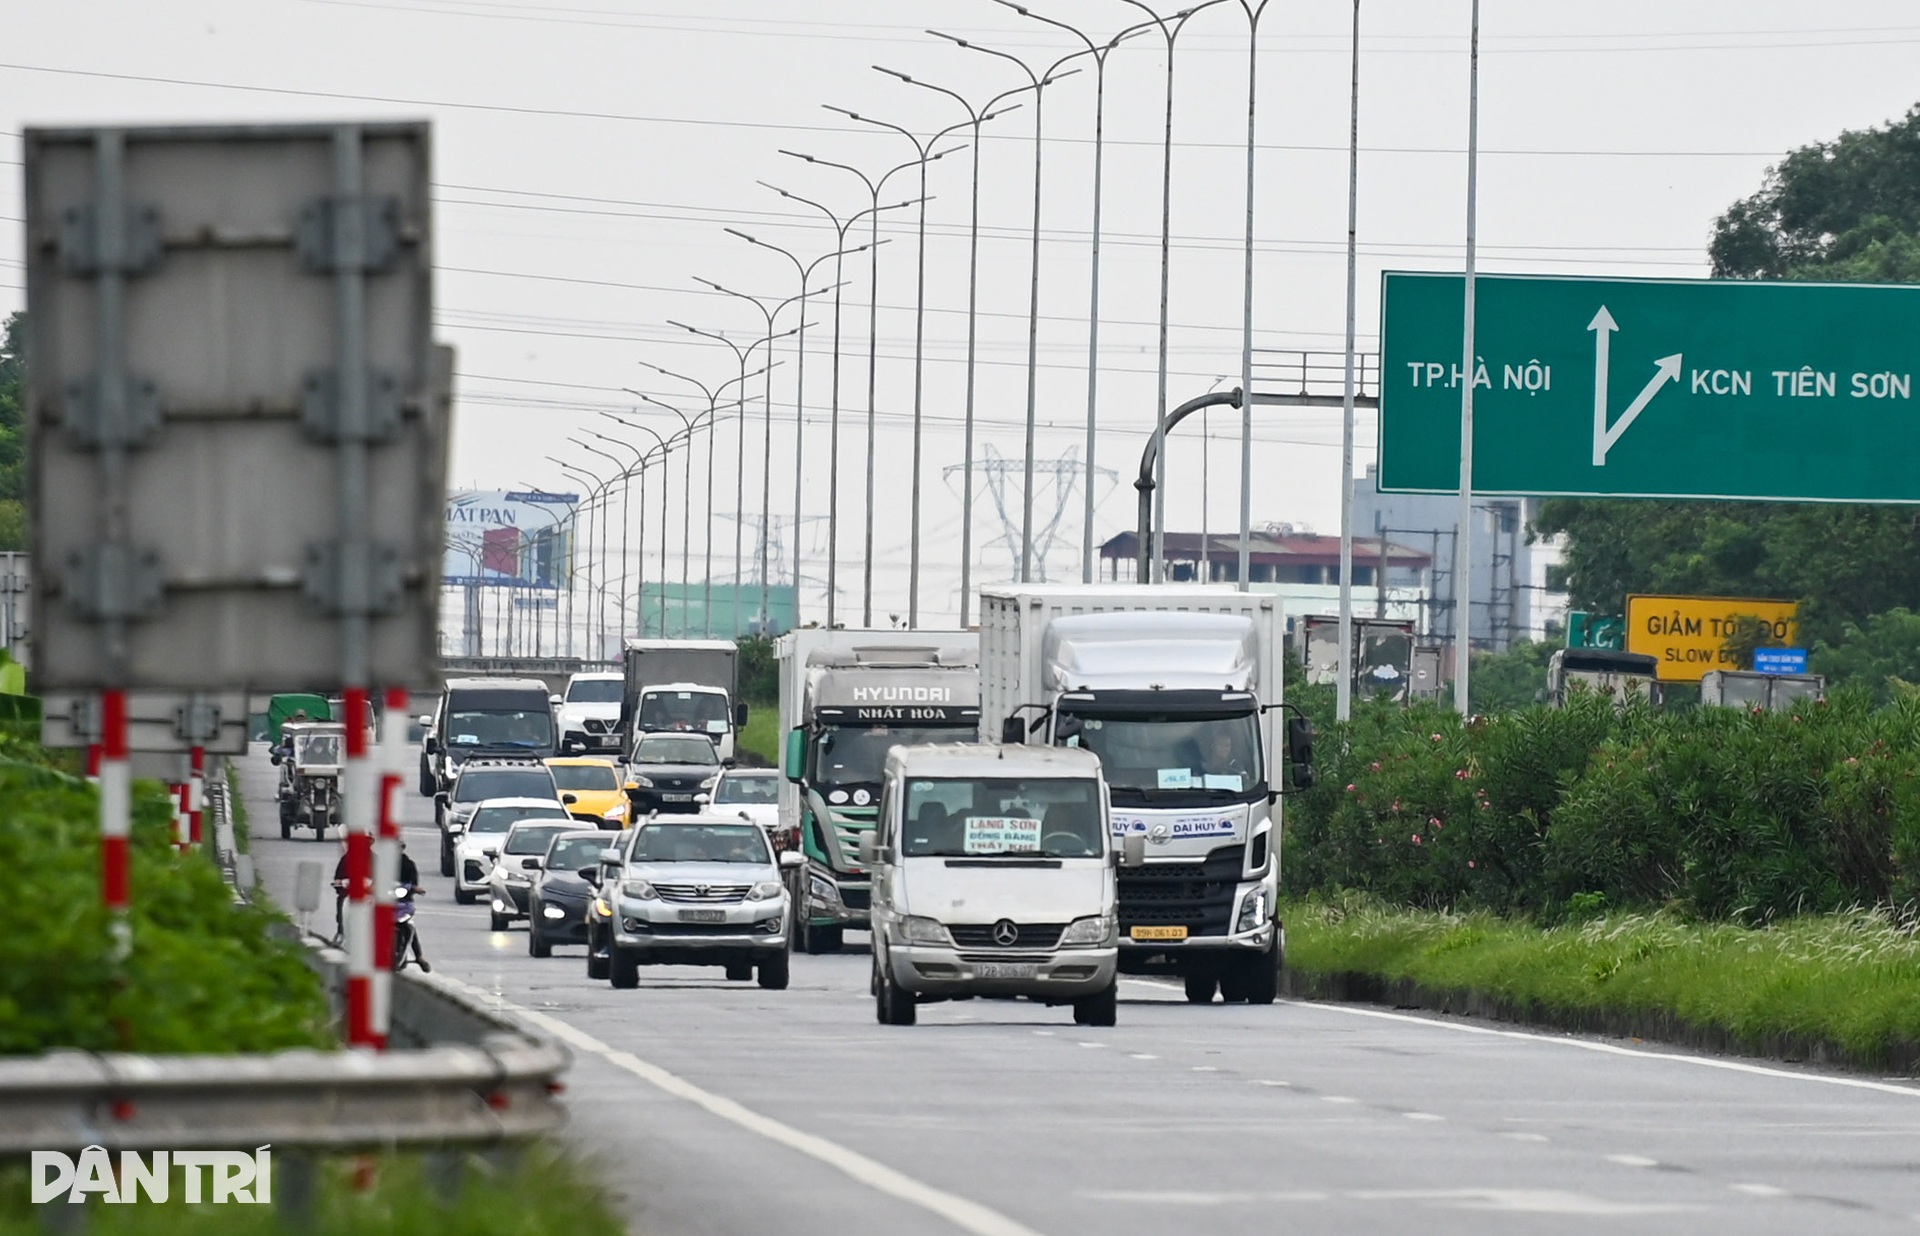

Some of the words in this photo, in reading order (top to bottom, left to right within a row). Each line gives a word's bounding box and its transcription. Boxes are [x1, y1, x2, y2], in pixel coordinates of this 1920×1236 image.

[1407, 356, 1492, 389] TP.HÀ
[1503, 359, 1551, 396] NỘI
[1691, 369, 1752, 396] KCN
[1772, 365, 1836, 397] TIÊN
[1850, 371, 1911, 399] SƠN
[1647, 610, 1702, 637] GIẢM
[1665, 647, 1714, 663] SLOW
[853, 687, 950, 702] HYUNDAI
[1195, 822, 1217, 832] HUY
